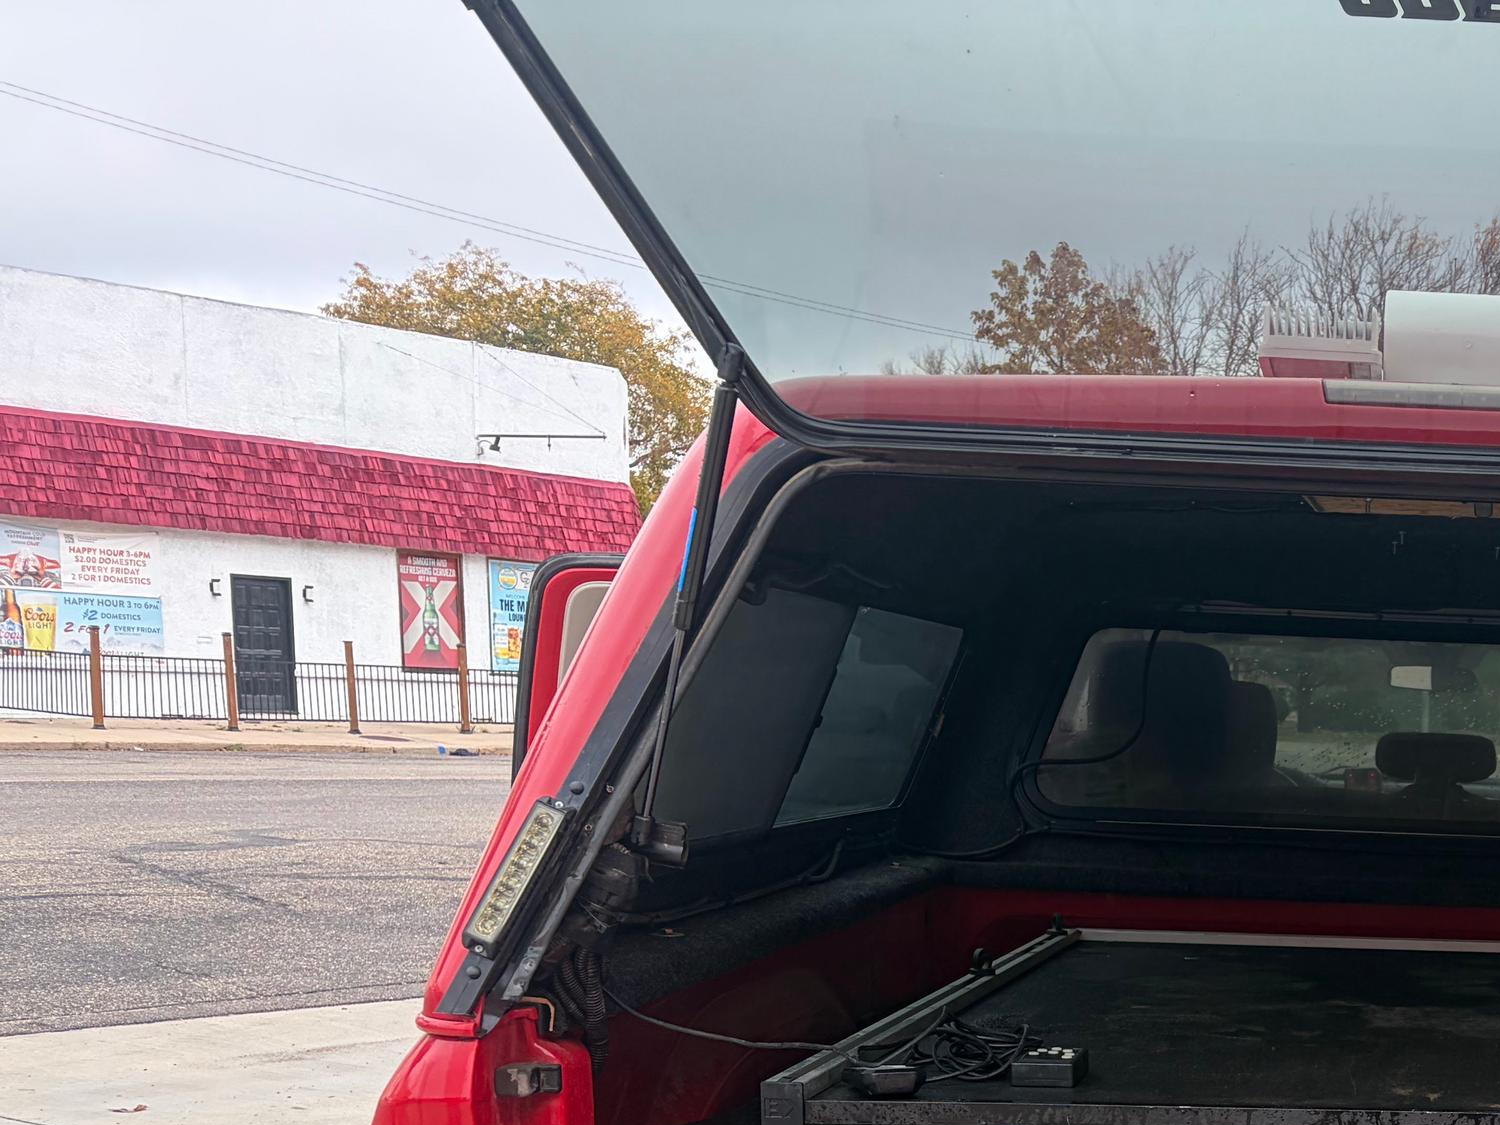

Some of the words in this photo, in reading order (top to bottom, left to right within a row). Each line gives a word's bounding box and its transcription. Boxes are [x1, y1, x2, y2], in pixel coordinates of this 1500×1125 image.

[68, 546, 97, 555] HAPPY
[99, 548, 124, 557] HOUR
[126, 550, 151, 559] 3-6PM
[75, 555, 96, 563] $2.00
[99, 557, 147, 567] DOMESTICS
[81, 565, 108, 573] EVERY
[110, 567, 140, 575] FRIDAY
[78, 574, 96, 582] FOR
[103, 575, 152, 585] DOMESTICS
[64, 596, 94, 606] HAPPY
[97, 599, 125, 608] HOUR
[126, 600, 132, 608] 3
[499, 599, 514, 611] THE
[82, 609, 98, 620] $2
[100, 612, 142, 621] DOMESTICS
[508, 613, 526, 622] LOUN
[64, 621, 74, 632] 2
[136, 626, 160, 634] FRIDAY
